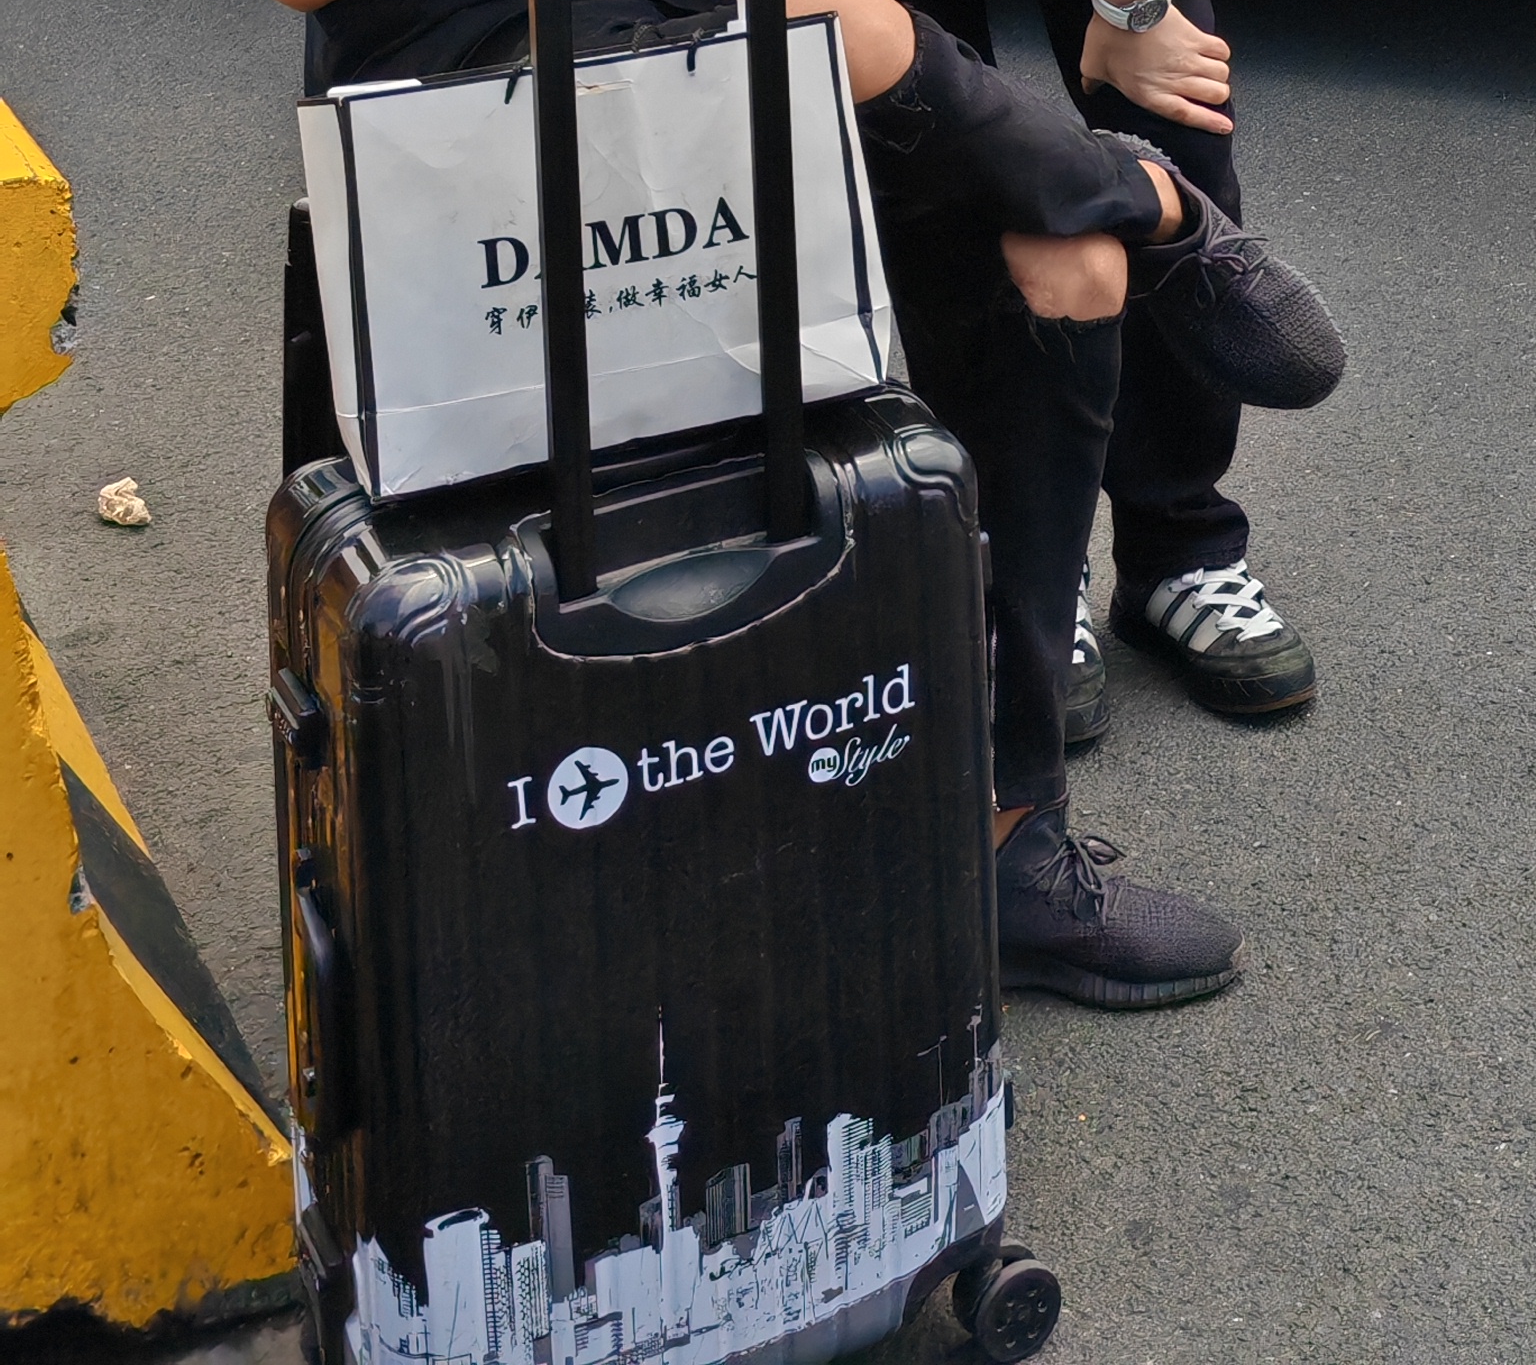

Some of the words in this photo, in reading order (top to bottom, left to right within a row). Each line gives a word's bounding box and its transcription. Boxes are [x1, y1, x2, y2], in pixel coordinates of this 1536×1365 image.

[477, 196, 750, 290] DMDA
[508, 776, 536, 829] I
[637, 735, 735, 792] the
[749, 663, 916, 758] World
[810, 755, 838, 774] my
[830, 723, 910, 786] Style
